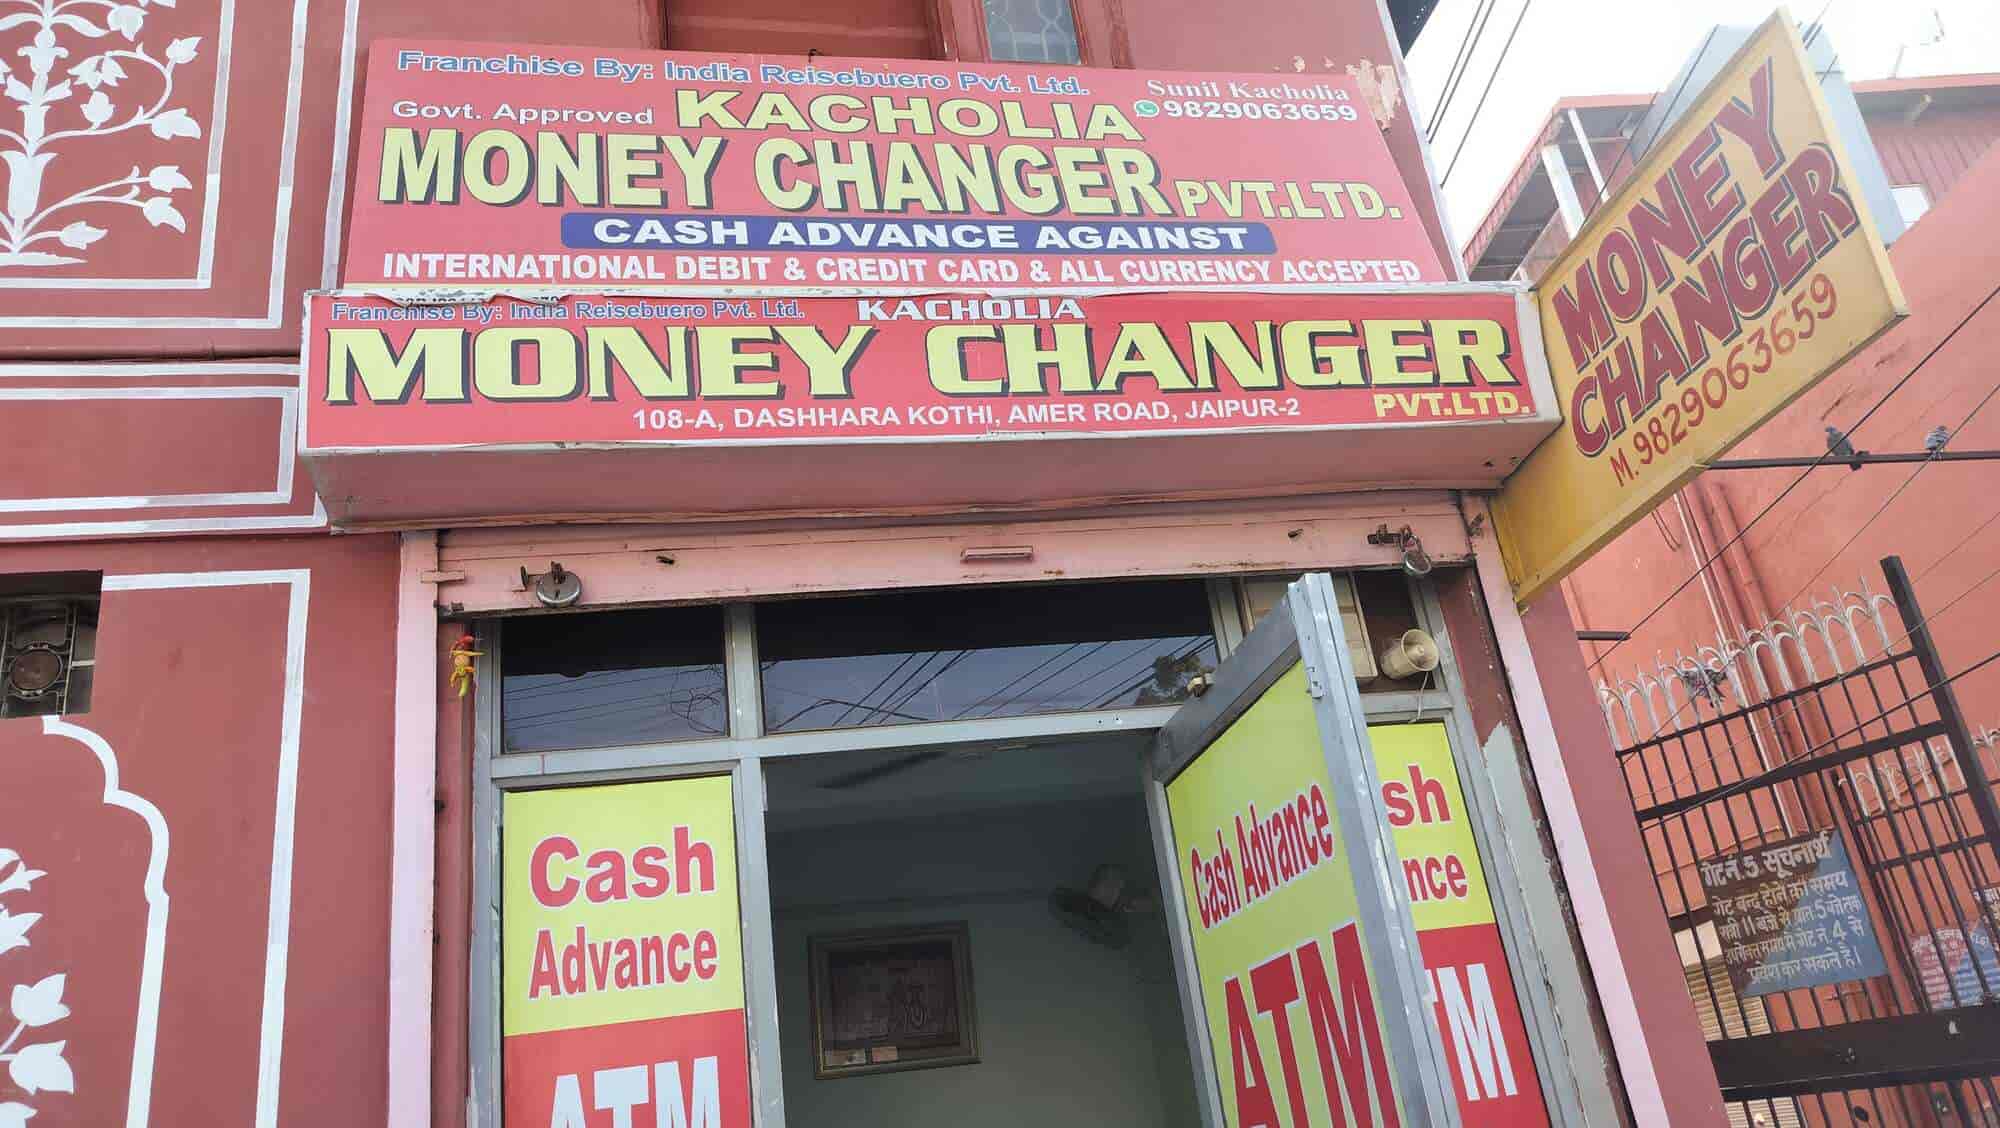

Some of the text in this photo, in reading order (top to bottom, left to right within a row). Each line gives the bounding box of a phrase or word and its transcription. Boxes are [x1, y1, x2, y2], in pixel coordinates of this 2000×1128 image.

[398, 51, 1090, 96] Franchise By: India Reisebuero Pvt. Ltd.
[1147, 79, 1351, 101] Sunil Kacholia
[392, 101, 654, 125] Govt. Approved
[674, 89, 1146, 142] KACHOLIA
[1163, 100, 1358, 121] 9829063659
[377, 127, 1404, 219] MONEY CHANGER PVT.LTD.
[1551, 56, 1787, 375] MONEY
[592, 218, 1249, 250] CASH ADVANCE AGAINST
[383, 252, 1421, 283] INTERNATIONAL DEBIT & CREDIT CARD & ALL CURRENCY ACCEPTED
[332, 300, 805, 323] Franchise By: India Reisebuero Pvt. Ltd.
[857, 298, 1085, 320] KACHOLIA
[1570, 142, 1861, 458] CHANGER
[324, 318, 1525, 405] MONEY CHANGER
[633, 397, 1301, 431] 108-A, DASHHARA KOTHI, AMER ROAD, JAIPUR-2
[1374, 392, 1530, 418] PVT.LTD.
[529, 824, 716, 909] Cash
[1190, 829, 1241, 930] Cash
[1235, 784, 1334, 906] Advance
[1744, 855, 1760, 877] 5
[1833, 920, 1847, 941] 4
[527, 924, 719, 1000] Advance
[1223, 921, 1401, 1128] ATM
